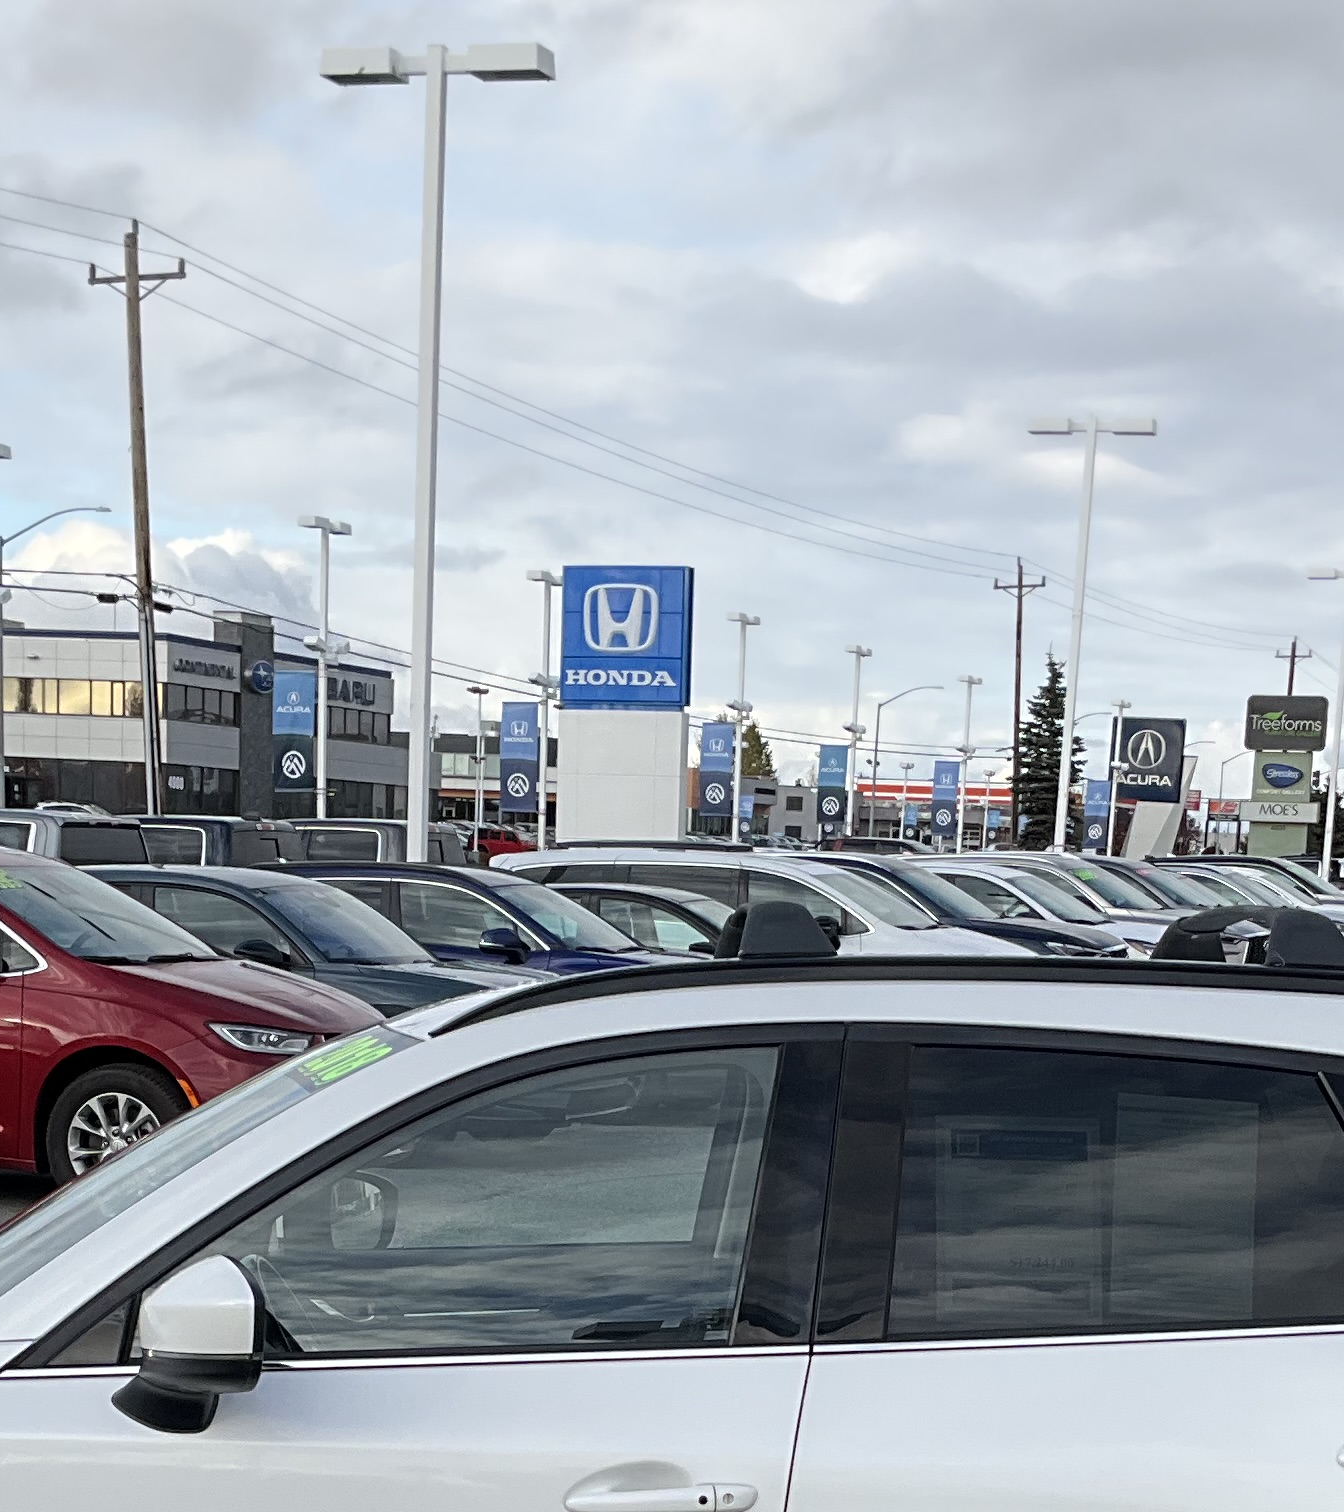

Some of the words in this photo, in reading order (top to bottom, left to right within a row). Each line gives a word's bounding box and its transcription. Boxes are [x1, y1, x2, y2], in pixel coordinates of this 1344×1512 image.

[564, 670, 677, 687] HONDA
[326, 677, 375, 706] BARU
[276, 705, 312, 714] ACURA
[1250, 714, 1322, 732] Treeforms
[1116, 773, 1172, 787] ACURA
[303, 1034, 393, 1082] 2018
